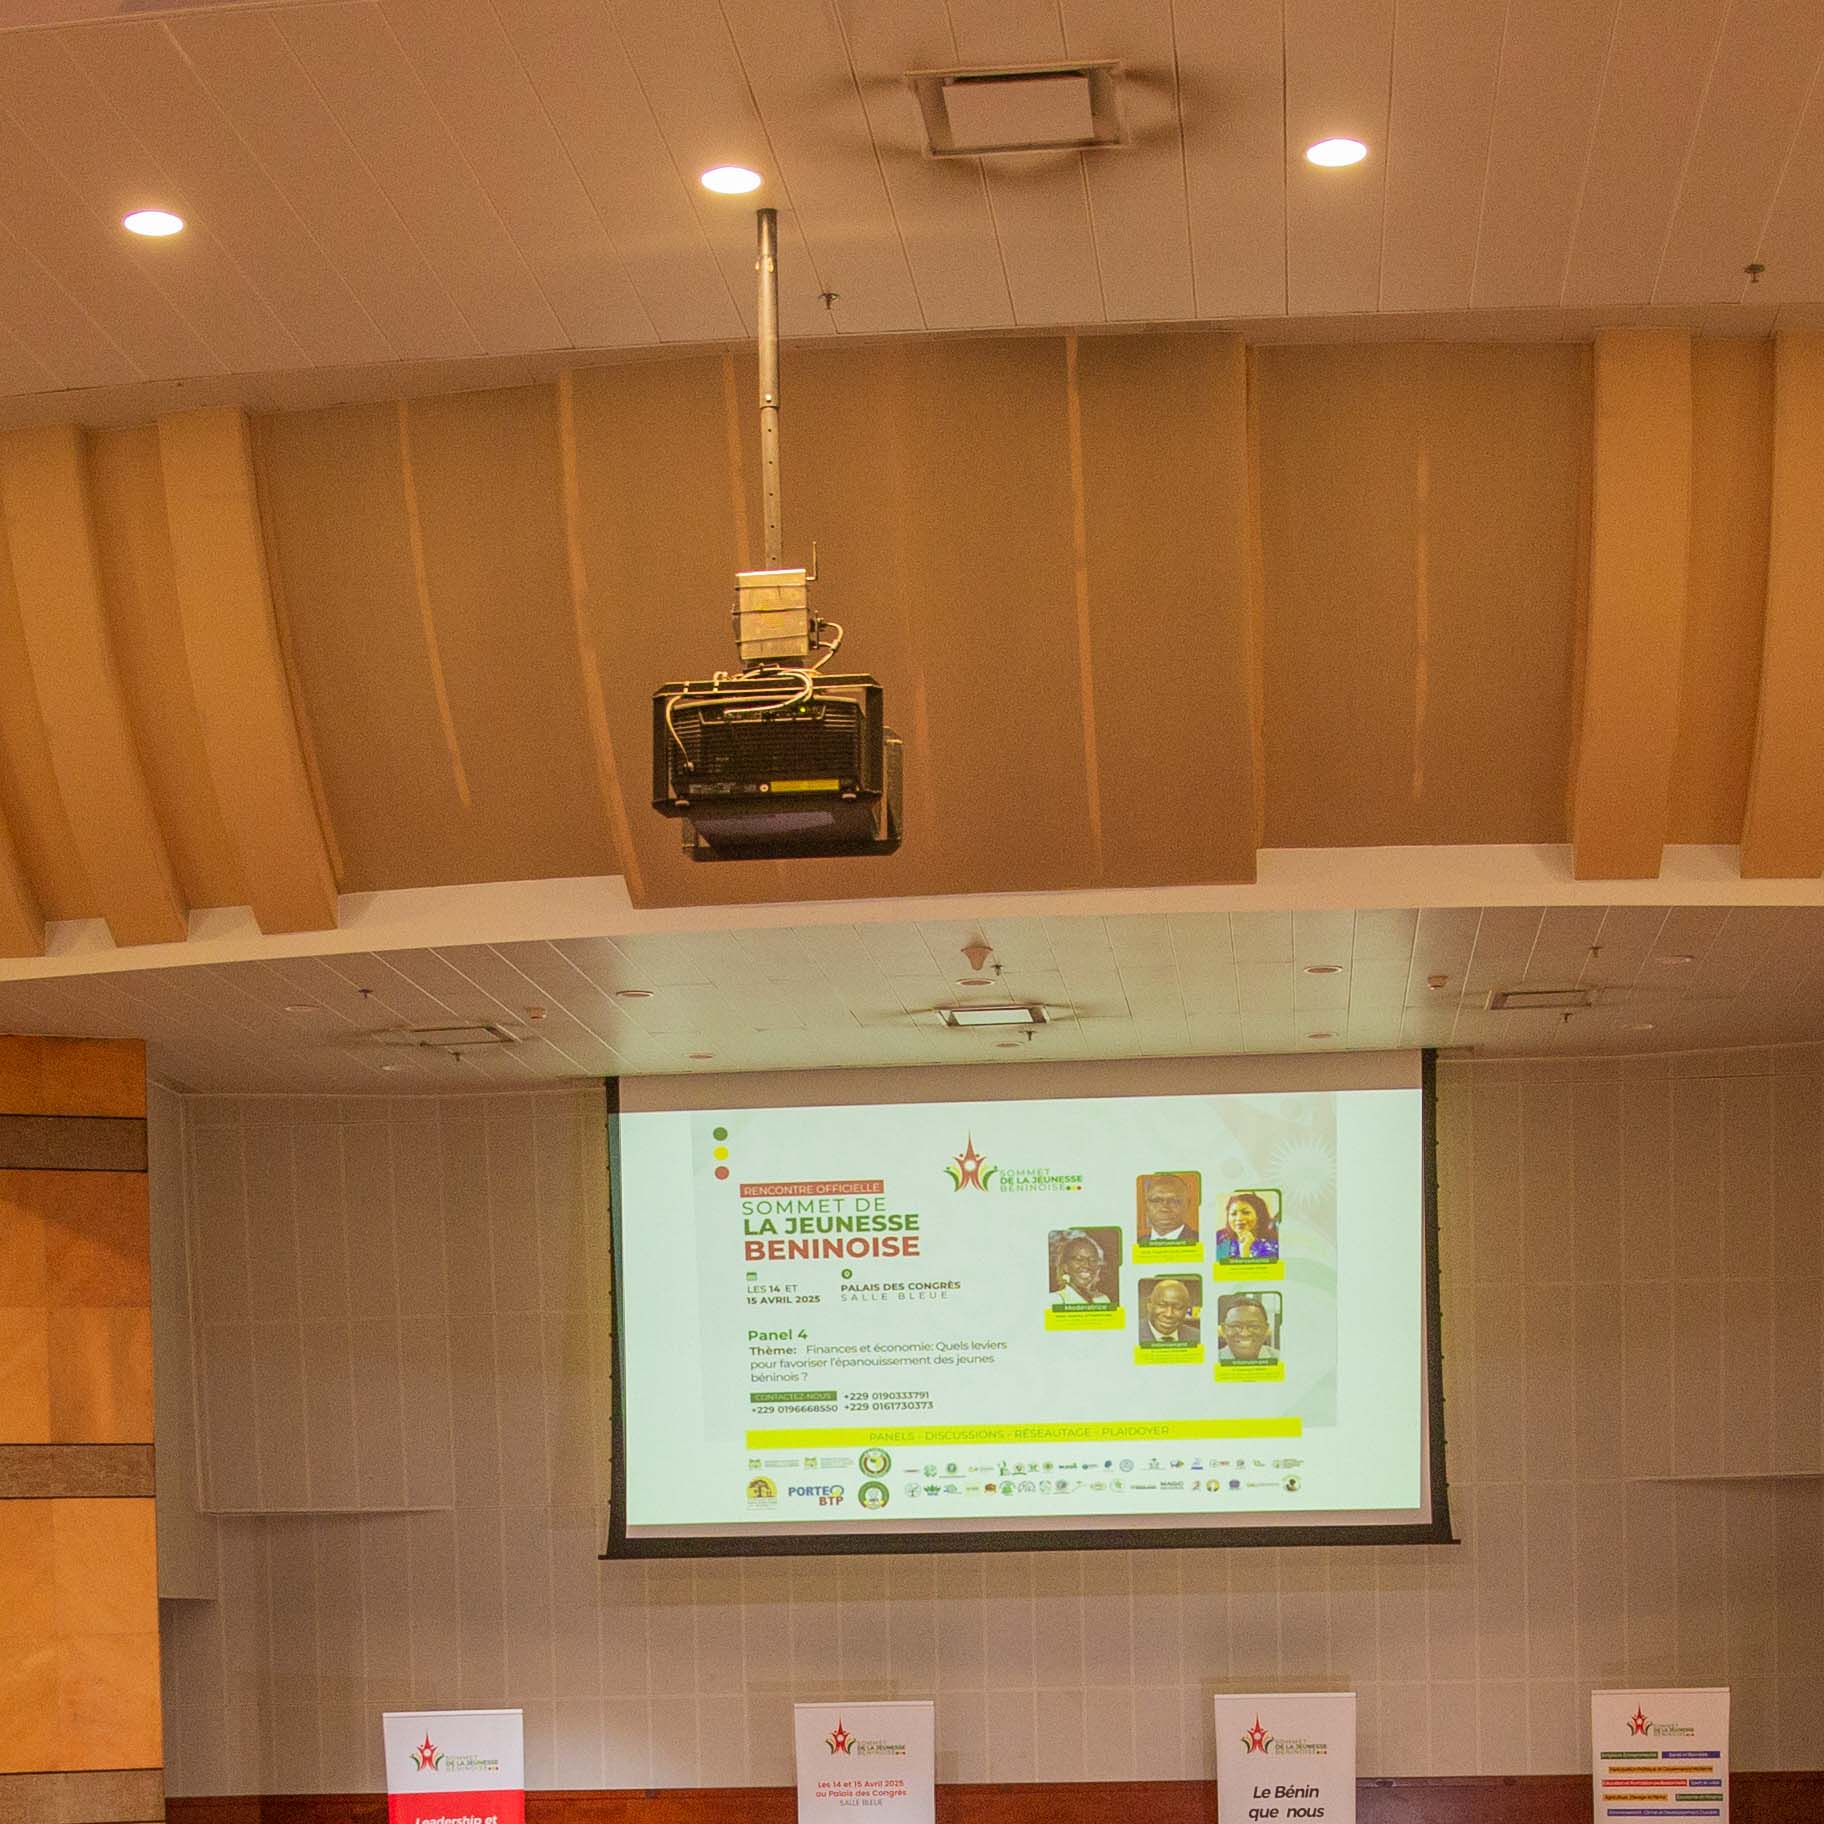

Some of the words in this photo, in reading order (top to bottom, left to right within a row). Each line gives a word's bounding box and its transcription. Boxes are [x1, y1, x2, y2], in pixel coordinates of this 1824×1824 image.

[1032, 1175, 1083, 1184] JEUNESSE
[744, 1184, 813, 1197] RENCONTRE
[816, 1181, 881, 1194] OFFICIELLE
[742, 1199, 846, 1216] SOMMET
[856, 1197, 887, 1212] DE
[744, 1218, 778, 1235] LA
[785, 1214, 920, 1234] JEUNESSE
[744, 1236, 920, 1261] BENINOISE
[747, 1285, 767, 1294] LES
[769, 1285, 781, 1293] 14
[785, 1284, 799, 1293] ET
[841, 1283, 880, 1293] PALAIS
[883, 1283, 905, 1291] DES
[908, 1280, 961, 1290] CONGRÈS
[747, 1296, 757, 1305] 15
[760, 1296, 792, 1304] AVRIL
[795, 1295, 821, 1304] 2025
[841, 1293, 888, 1302] SALLE
[898, 1291, 948, 1300] BLEUE
[748, 1329, 793, 1341] Panel
[797, 1329, 808, 1340] 4
[749, 1345, 797, 1356] Thème:
[806, 1344, 858, 1355] Finances
[859, 1344, 871, 1353] et
[936, 1341, 969, 1352] Quels
[971, 1340, 1008, 1350] leviers
[750, 1360, 776, 1371] pour
[779, 1357, 827, 1368] favoriser
[933, 1354, 954, 1365] des
[955, 1354, 995, 1366] jeunes
[751, 1371, 800, 1383] béninois
[844, 1392, 869, 1401] +229
[872, 1391, 929, 1401] 0190333791
[751, 1405, 775, 1415] +229
[844, 1402, 869, 1412] +229
[872, 1401, 934, 1411] 0161730373
[869, 1431, 914, 1441] PANELS
[925, 1429, 1005, 1441] DISCUSSIONS
[1102, 1425, 1169, 1437] PLAIDOYER
[819, 1496, 844, 1507] BTP
[1253, 1786, 1271, 1799] Le
[1275, 1784, 1319, 1798] Bénin
[484, 1815, 498, 1824] et
[1248, 1808, 1279, 1821] que
[1286, 1807, 1325, 1818] nous
